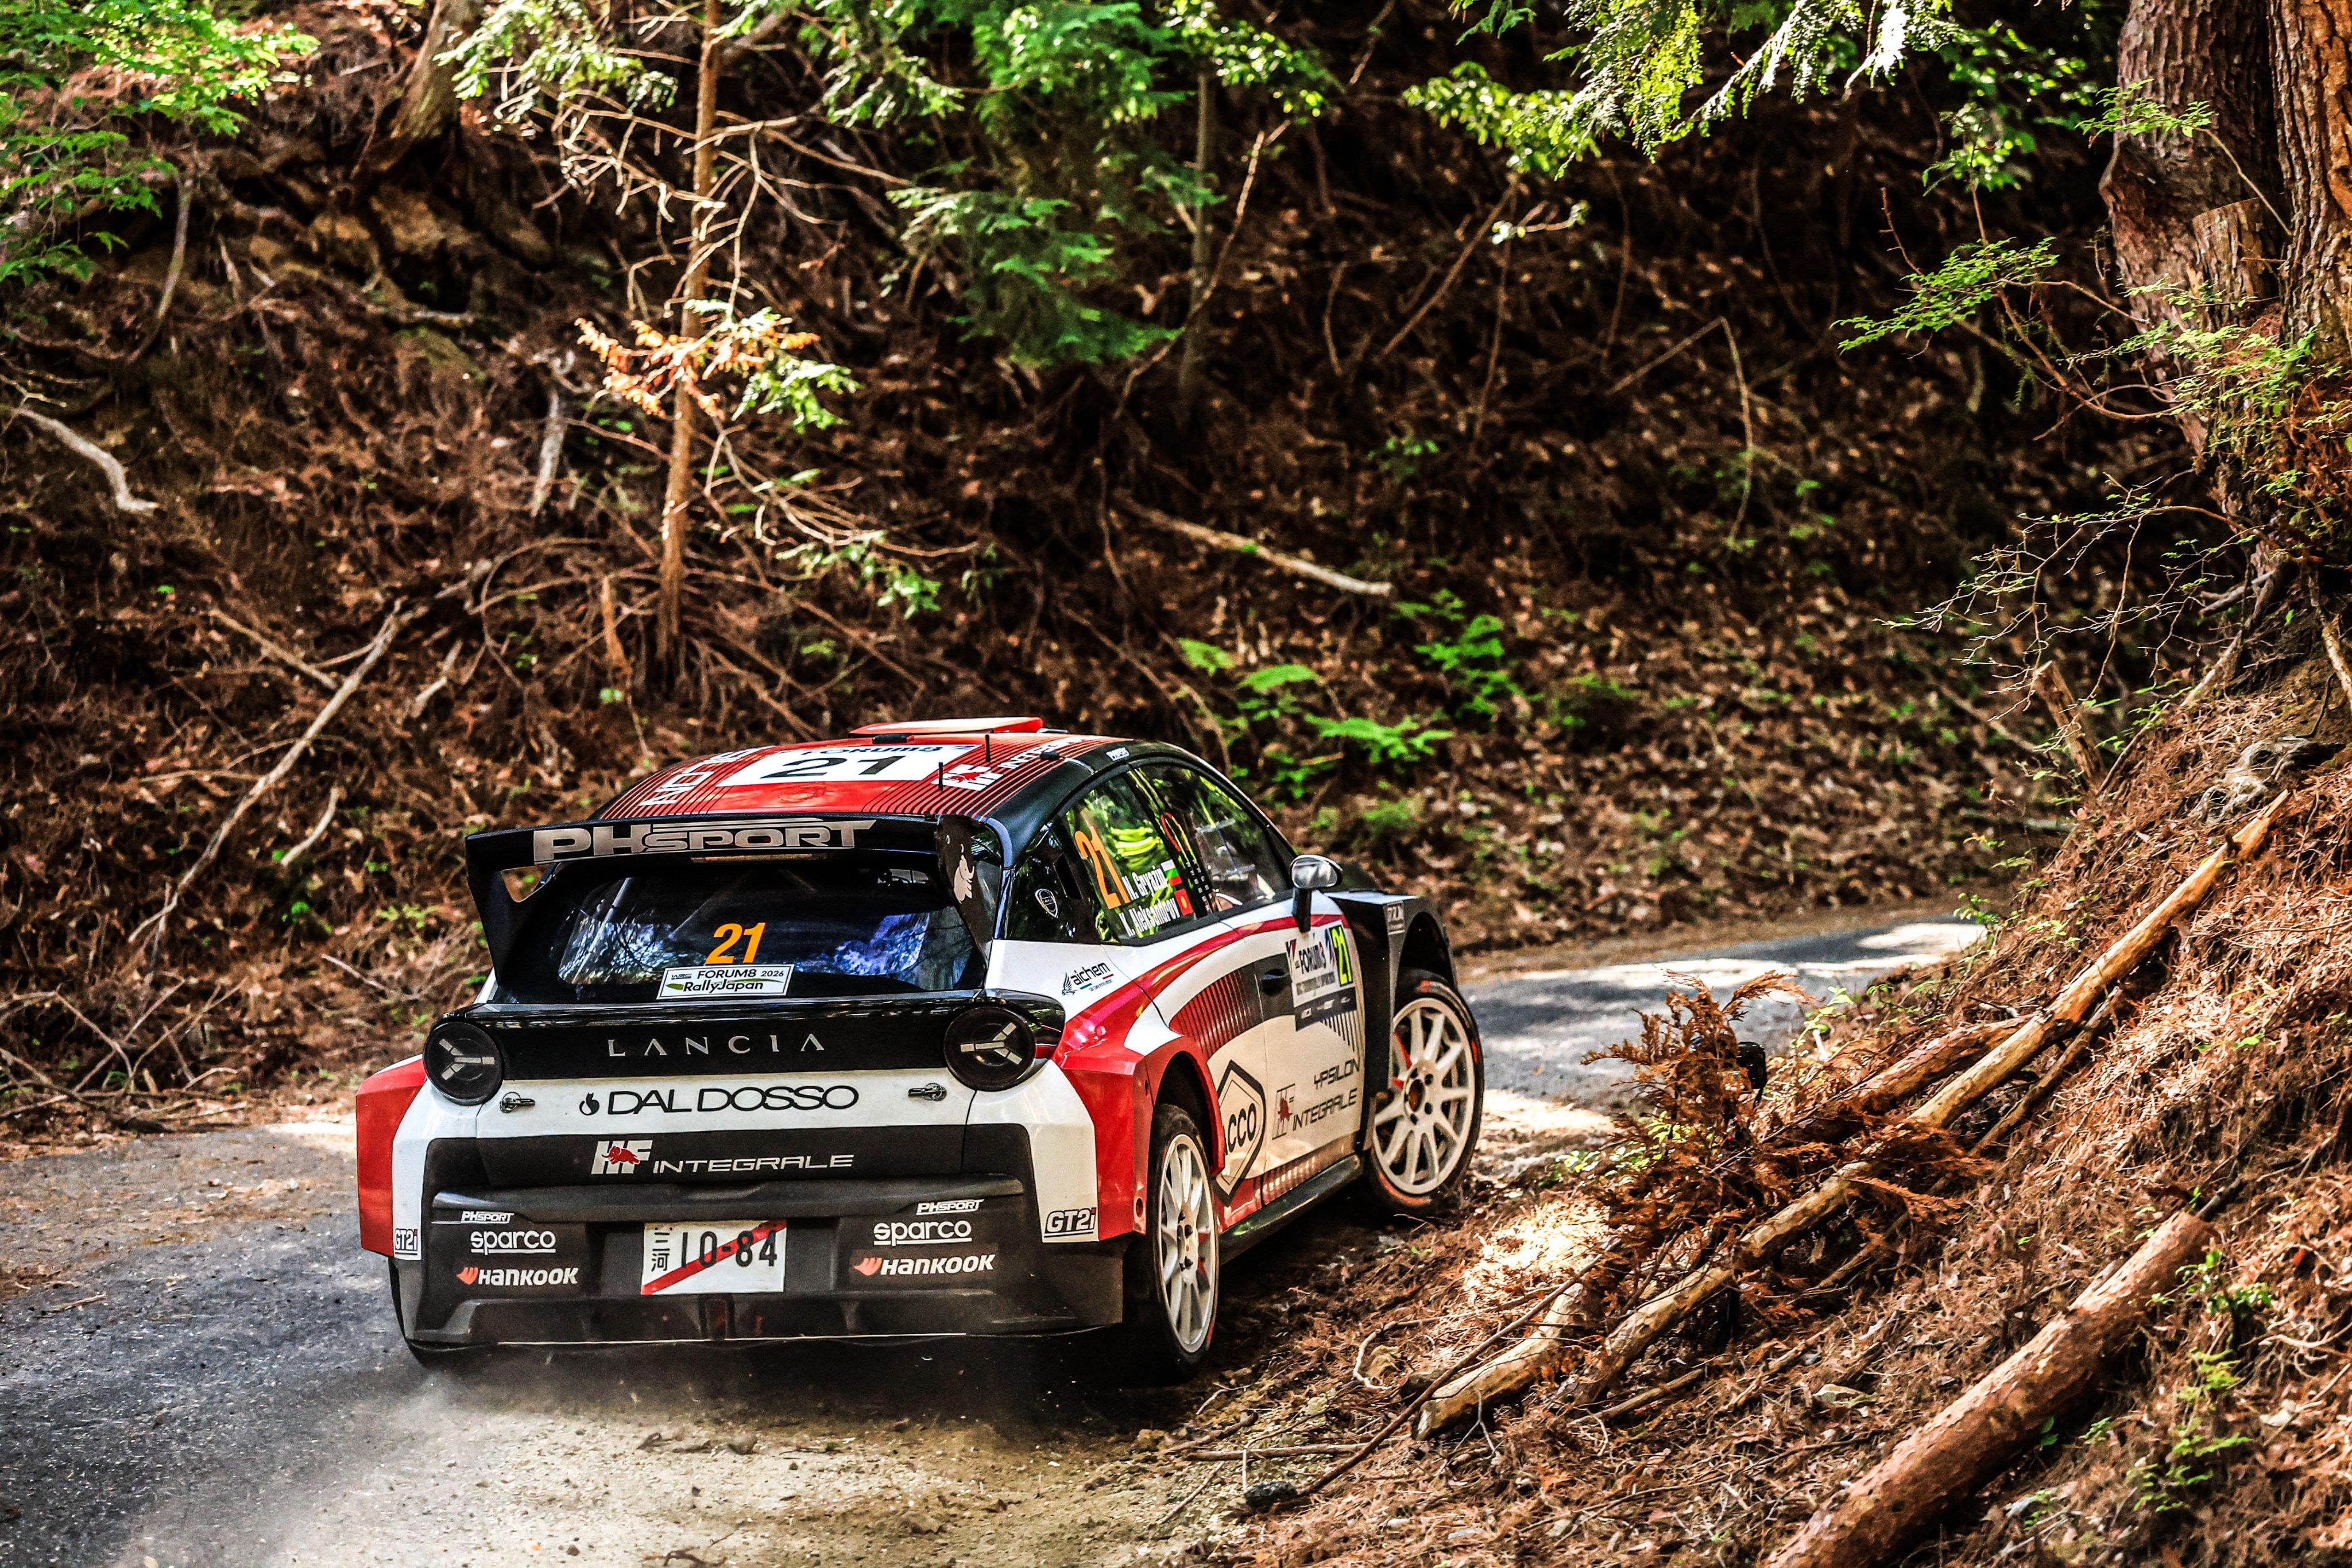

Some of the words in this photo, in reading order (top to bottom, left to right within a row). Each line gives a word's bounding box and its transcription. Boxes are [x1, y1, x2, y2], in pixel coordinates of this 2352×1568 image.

[760, 756, 906, 779] 21
[1075, 826, 1131, 909] 21
[1121, 876, 1139, 901] N.
[1132, 865, 1169, 897] Gryazin
[1128, 898, 1181, 933] Aleksandrov
[705, 922, 766, 965] 21
[1331, 926, 1352, 985] 21
[697, 969, 757, 979] FORUM8
[1070, 962, 1111, 985] aichem
[608, 1034, 825, 1057] LANCIA
[1314, 1058, 1360, 1090] YPSILON
[1293, 1088, 1357, 1131] INTEGRALE
[1224, 1102, 1257, 1156] CCO
[653, 1154, 854, 1174] INTEGRALE
[461, 1210, 514, 1224] PHSPORT
[917, 1199, 985, 1215] PHSPORT
[873, 1221, 972, 1246] sparco
[1045, 1208, 1097, 1233] GT2i
[394, 1228, 418, 1250] GT2i
[470, 1230, 556, 1256] sparco
[651, 1232, 670, 1272] 三河
[681, 1230, 777, 1268] 10-84
